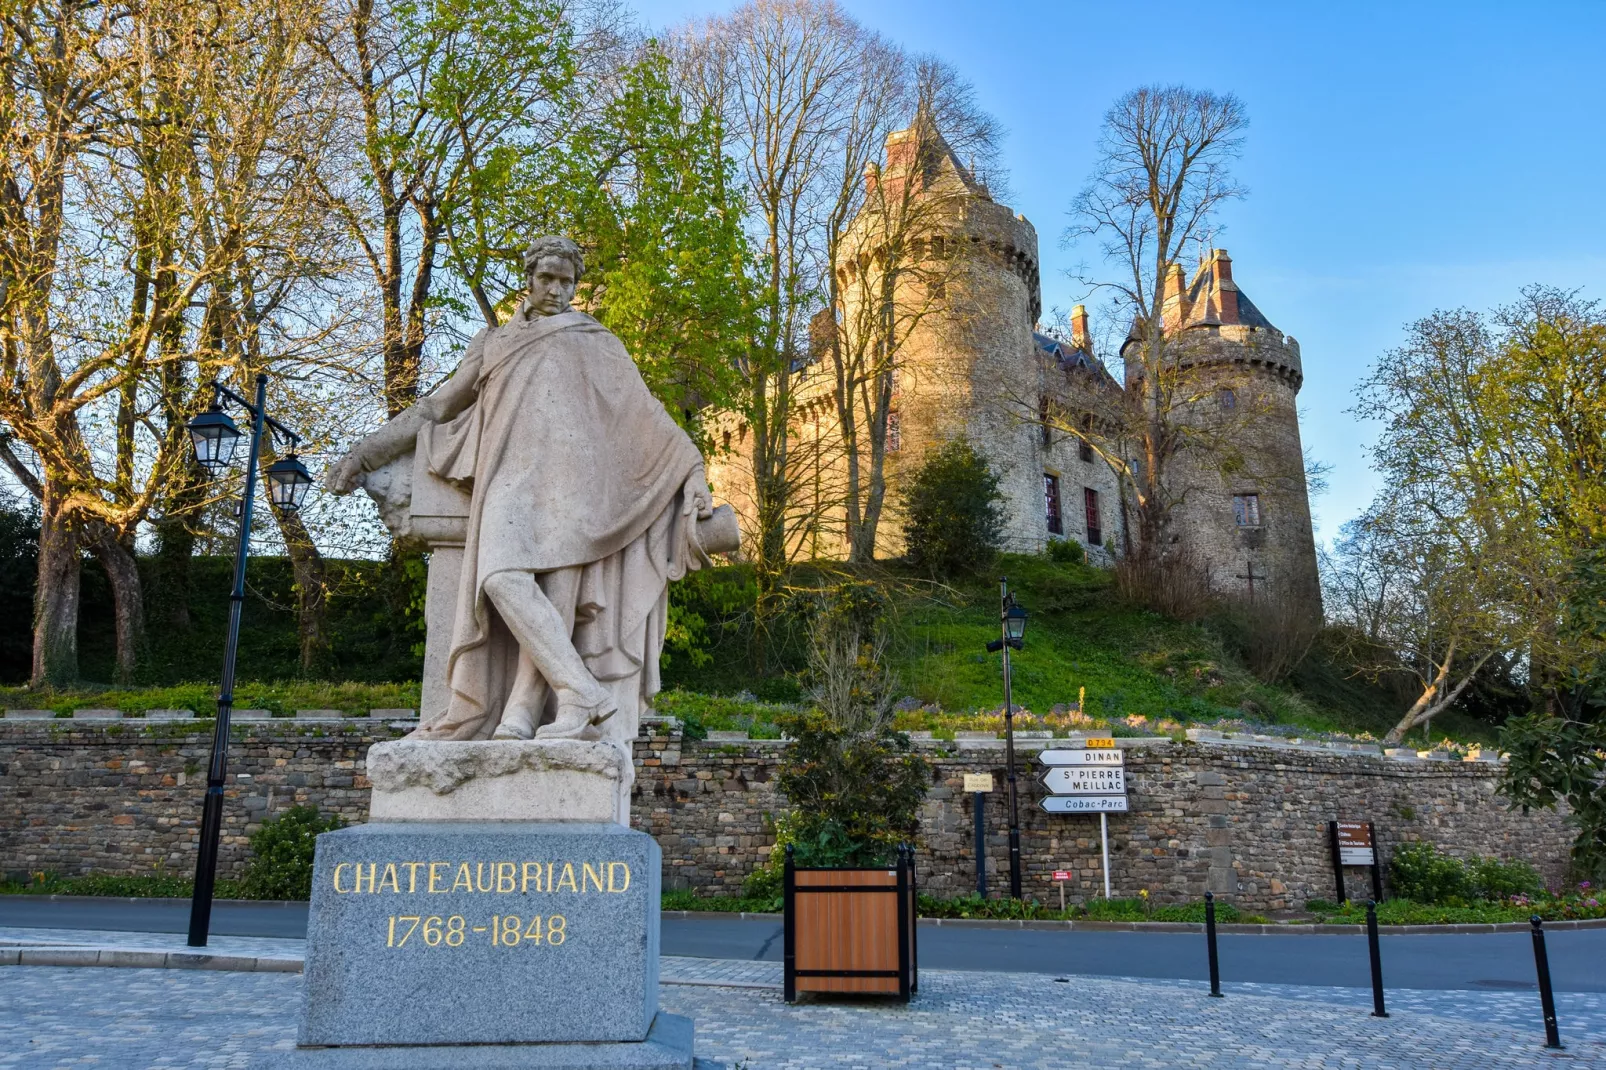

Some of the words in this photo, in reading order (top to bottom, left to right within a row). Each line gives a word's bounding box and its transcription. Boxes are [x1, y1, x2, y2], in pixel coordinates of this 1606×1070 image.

[1085, 753, 1120, 761] DINAN
[1079, 770, 1121, 779] PIERRE
[1072, 781, 1121, 790] MEILLAC
[1065, 799, 1123, 809] Cobac-Parc
[333, 861, 631, 894] CHATEAUBRIAND
[387, 914, 567, 948] 1768-1848
